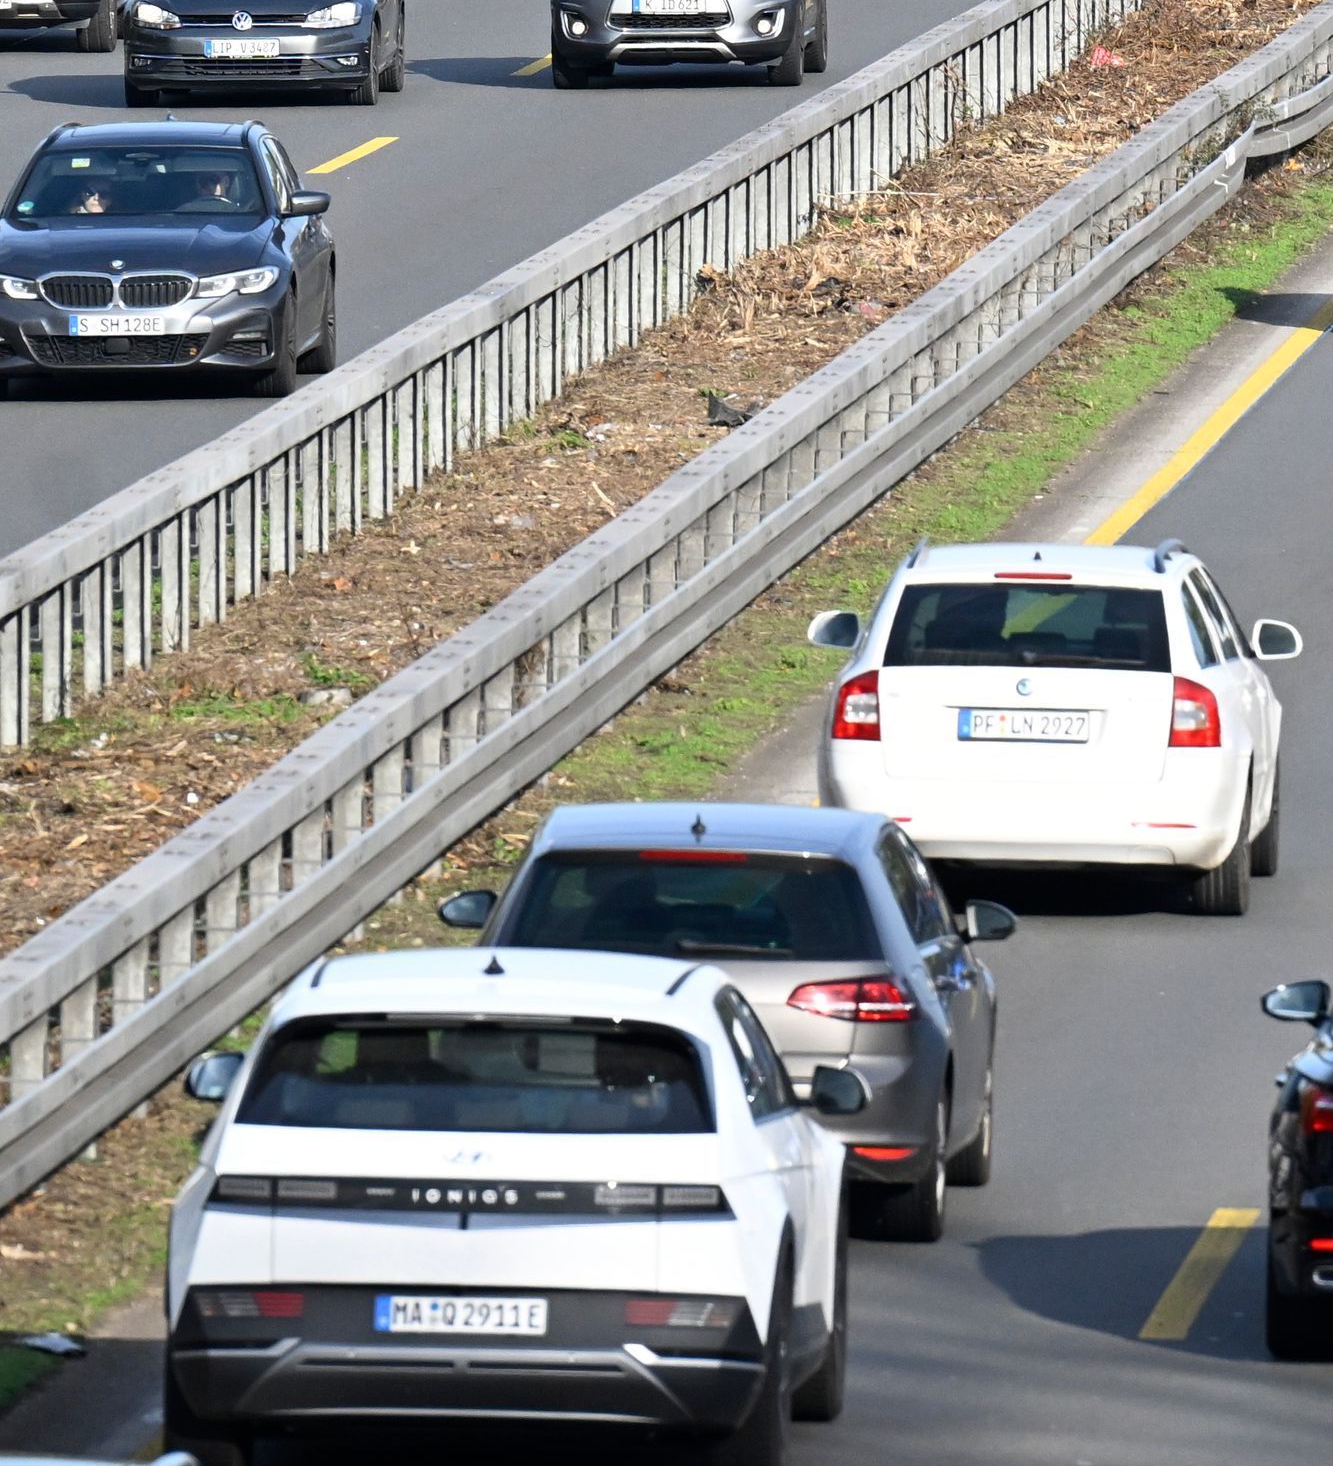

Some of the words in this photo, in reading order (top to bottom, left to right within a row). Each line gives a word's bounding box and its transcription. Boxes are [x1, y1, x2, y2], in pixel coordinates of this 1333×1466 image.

[213, 42, 232, 54] LIP
[80, 318, 88, 333] S
[101, 318, 120, 333] SH
[123, 318, 161, 332] 128E
[973, 714, 994, 732] PF
[1010, 716, 1033, 734] LN
[1040, 717, 1086, 736] 2927
[391, 1300, 422, 1325] MA
